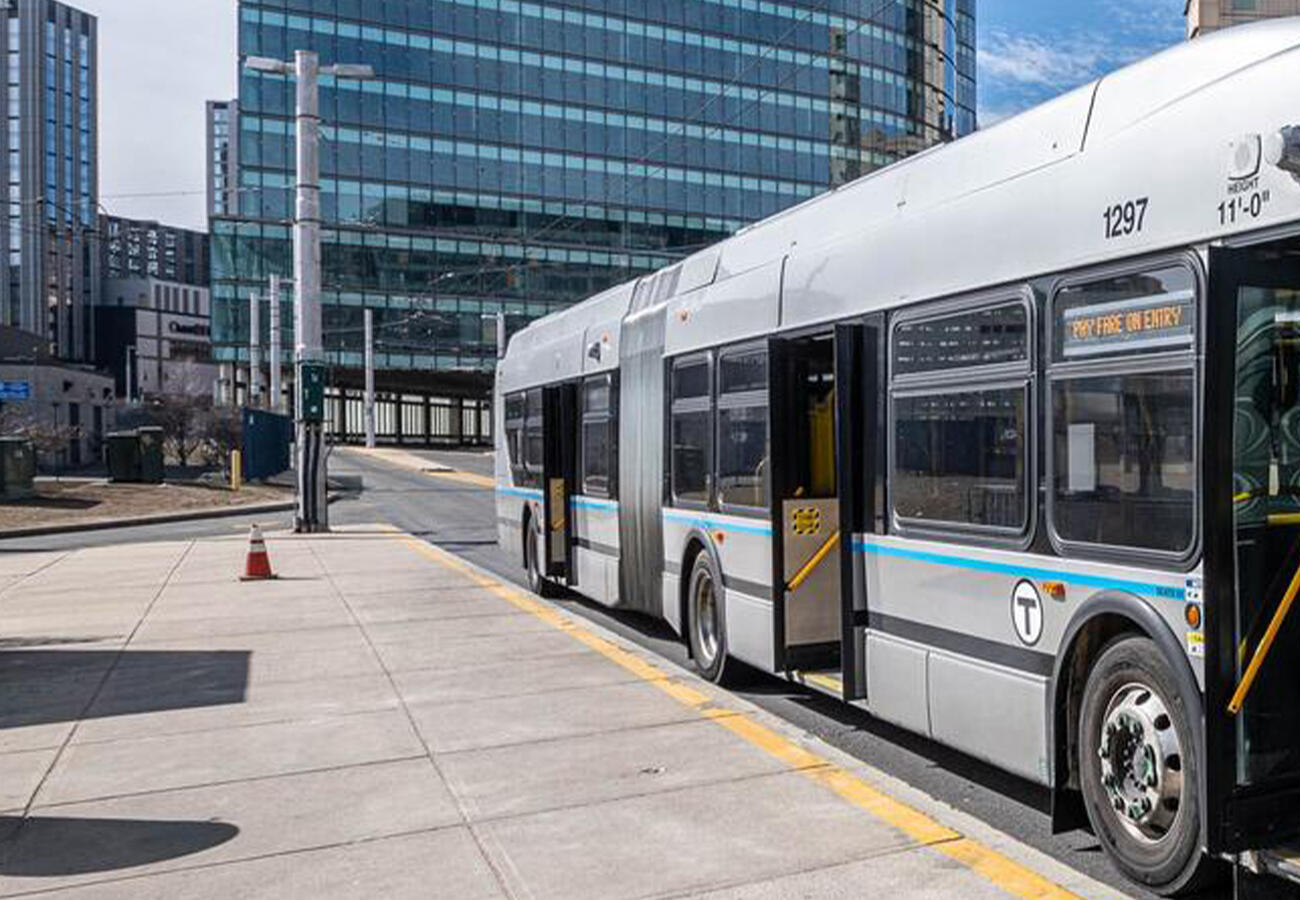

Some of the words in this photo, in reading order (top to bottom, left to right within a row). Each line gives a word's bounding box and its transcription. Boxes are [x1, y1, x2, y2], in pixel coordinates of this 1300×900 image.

[1228, 177, 1259, 194] HEIGHT
[1103, 197, 1148, 238] 1297
[1218, 190, 1270, 224] 11'-0"
[1072, 318, 1096, 340] PAY
[1097, 313, 1122, 336] FARE
[1125, 310, 1143, 332] ON
[1144, 305, 1182, 330] ENTRY
[1017, 596, 1036, 635] T
